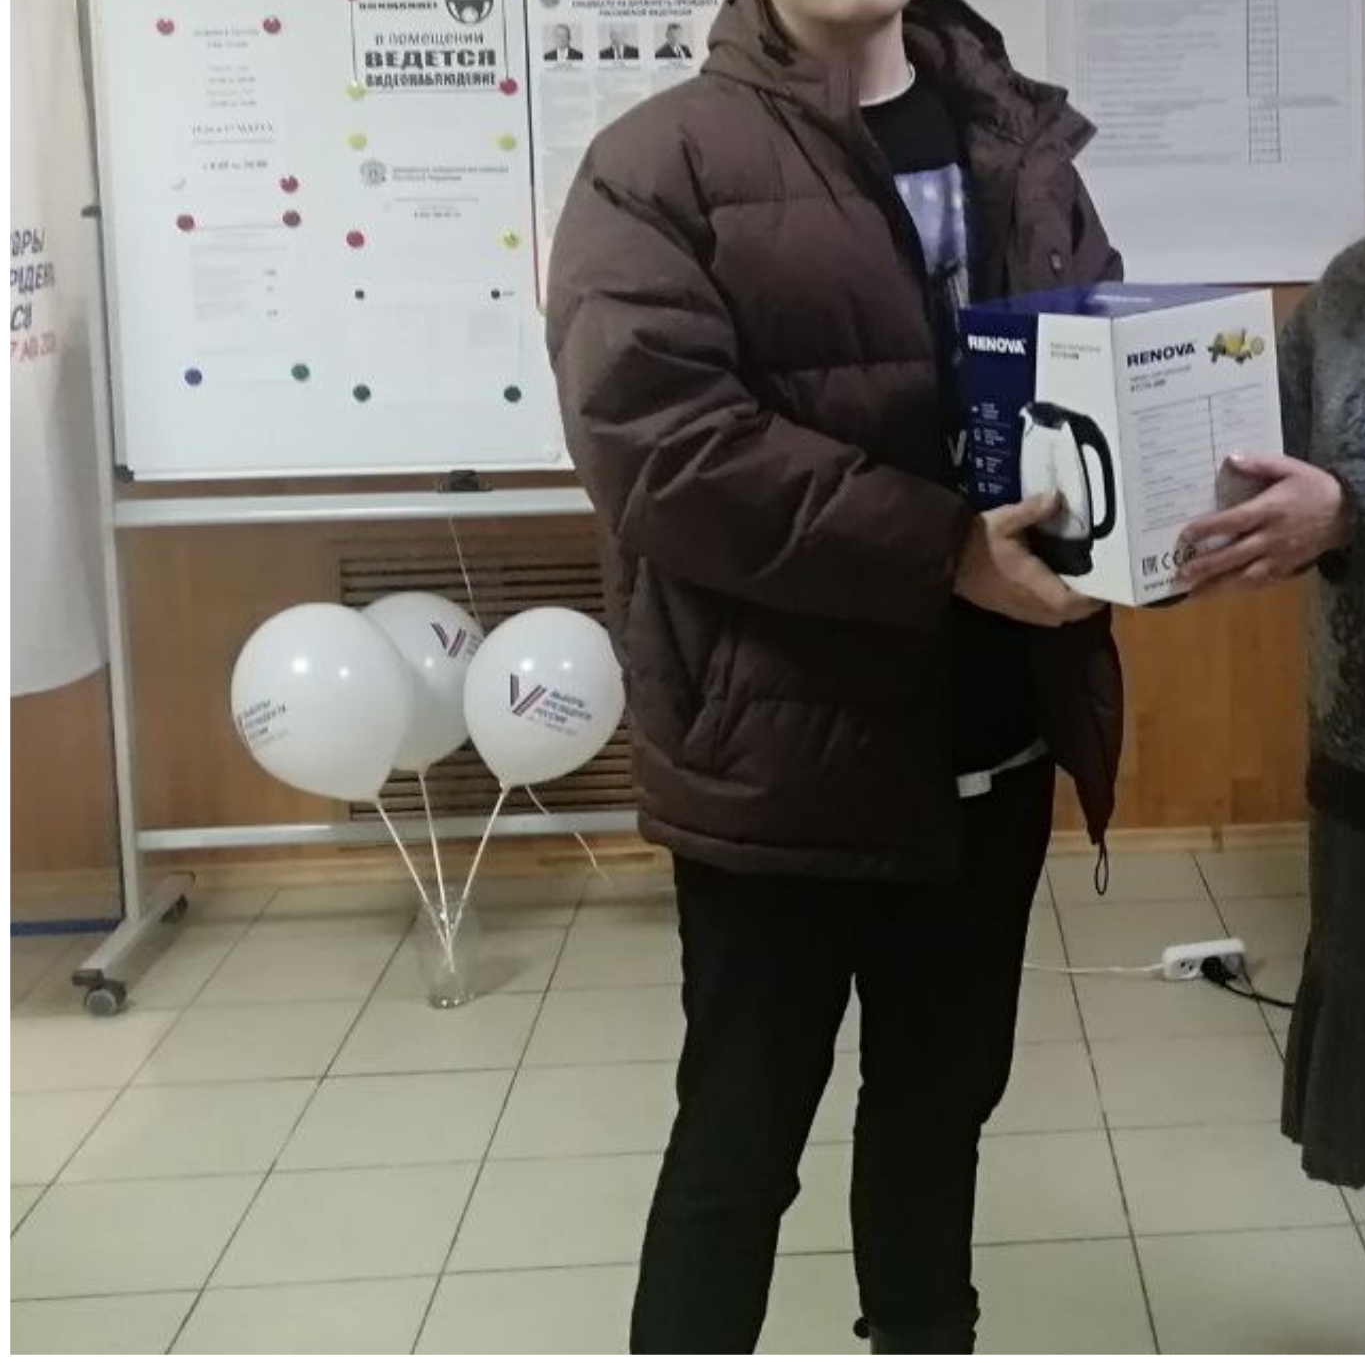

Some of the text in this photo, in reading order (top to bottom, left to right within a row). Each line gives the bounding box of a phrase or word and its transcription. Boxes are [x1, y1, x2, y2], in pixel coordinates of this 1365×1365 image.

[365, 49, 496, 70] ВЕДЕТСЯ
[967, 334, 1027, 356] RENOVA
[1127, 342, 1196, 367] RENOVA
